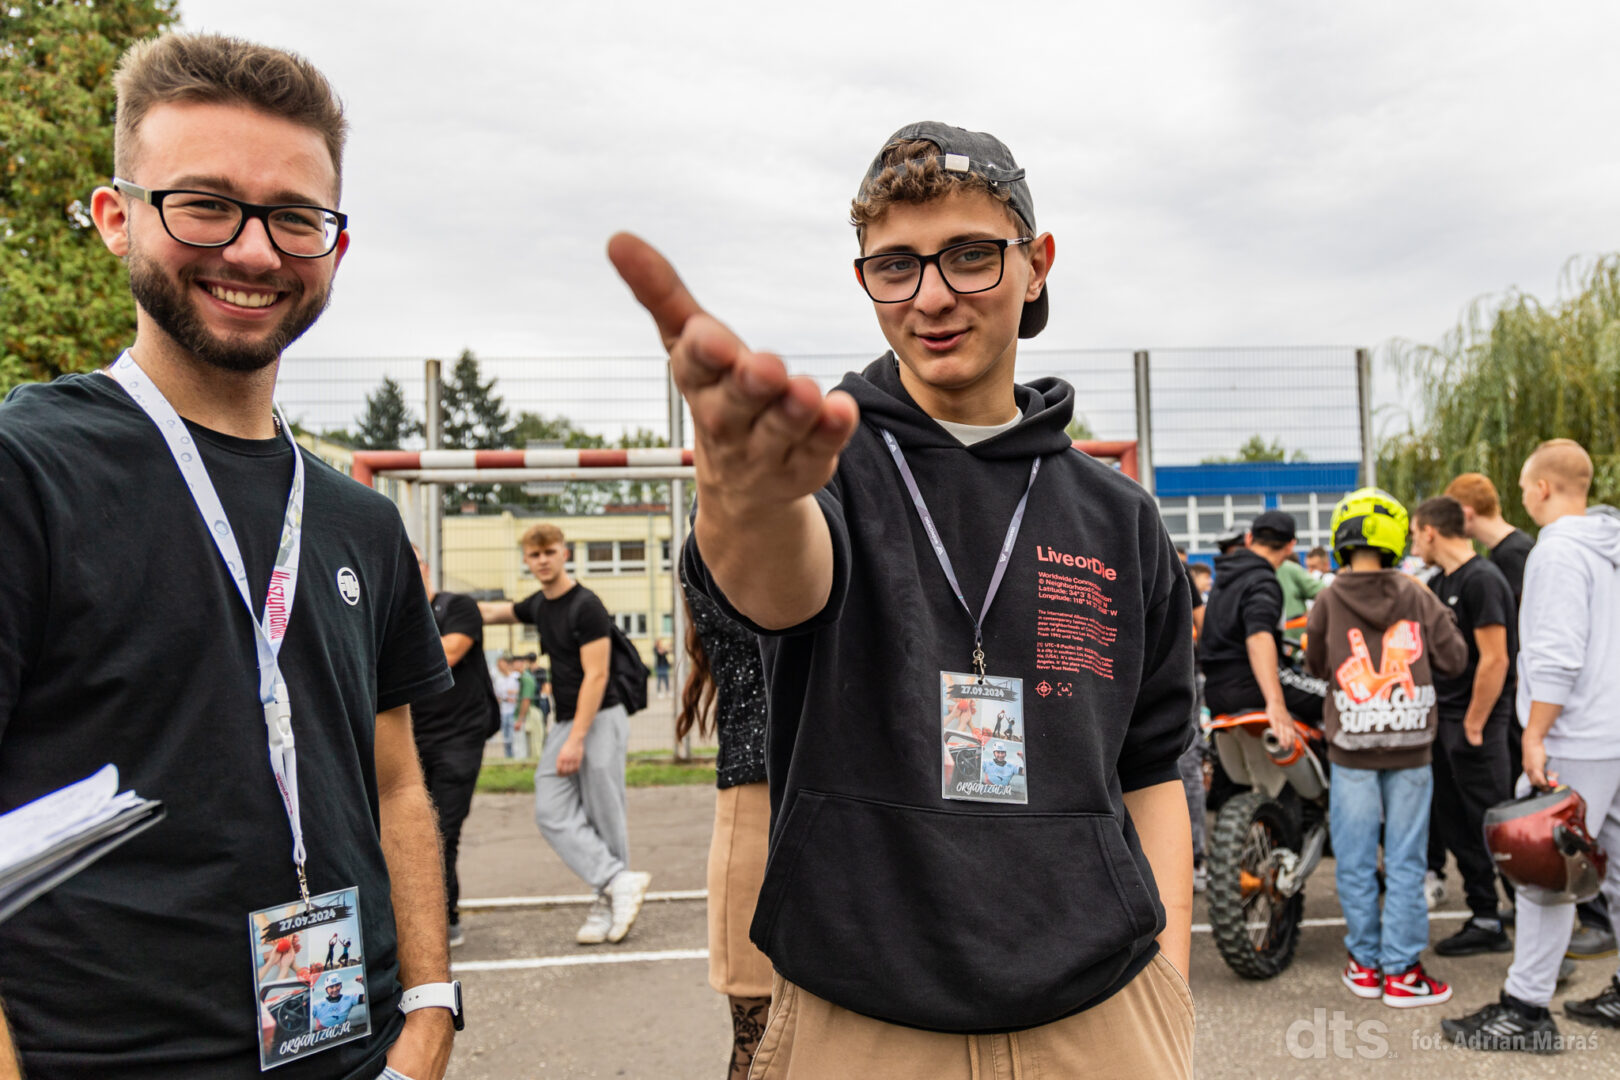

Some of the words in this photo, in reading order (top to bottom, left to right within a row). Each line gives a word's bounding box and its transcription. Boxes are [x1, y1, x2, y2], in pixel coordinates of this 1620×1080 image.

[1036, 545, 1117, 581] LiveorDie
[1038, 571, 1073, 583] Worldwide
[961, 685, 1005, 698] 27.09.2024
[1339, 708, 1431, 733] SUPPORT
[278, 908, 336, 932] 27.09.2024
